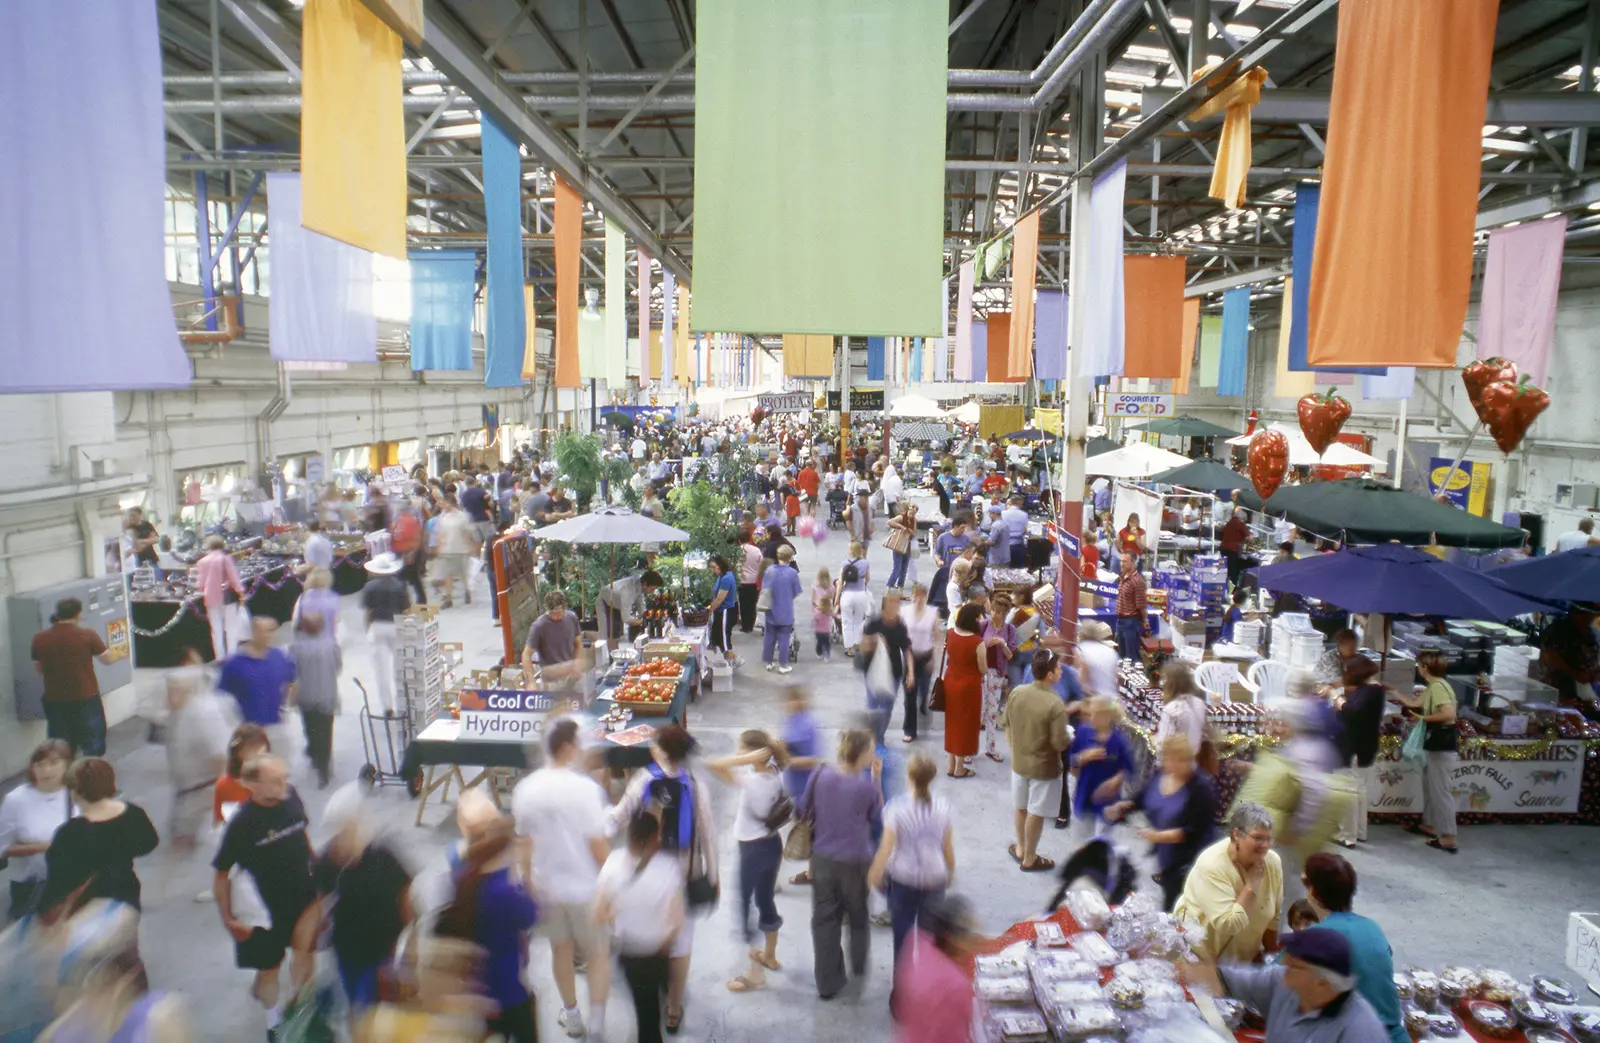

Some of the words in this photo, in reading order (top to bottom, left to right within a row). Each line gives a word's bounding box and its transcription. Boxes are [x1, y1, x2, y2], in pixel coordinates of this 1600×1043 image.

[760, 395, 811, 409] PROTEAS
[1119, 395, 1161, 403] GOURMET
[1114, 402, 1166, 414] FOOD
[487, 693, 521, 710] Cool
[1450, 764, 1486, 781] ZROY
[1484, 767, 1514, 791] FALLS
[1513, 789, 1570, 809] Sauces
